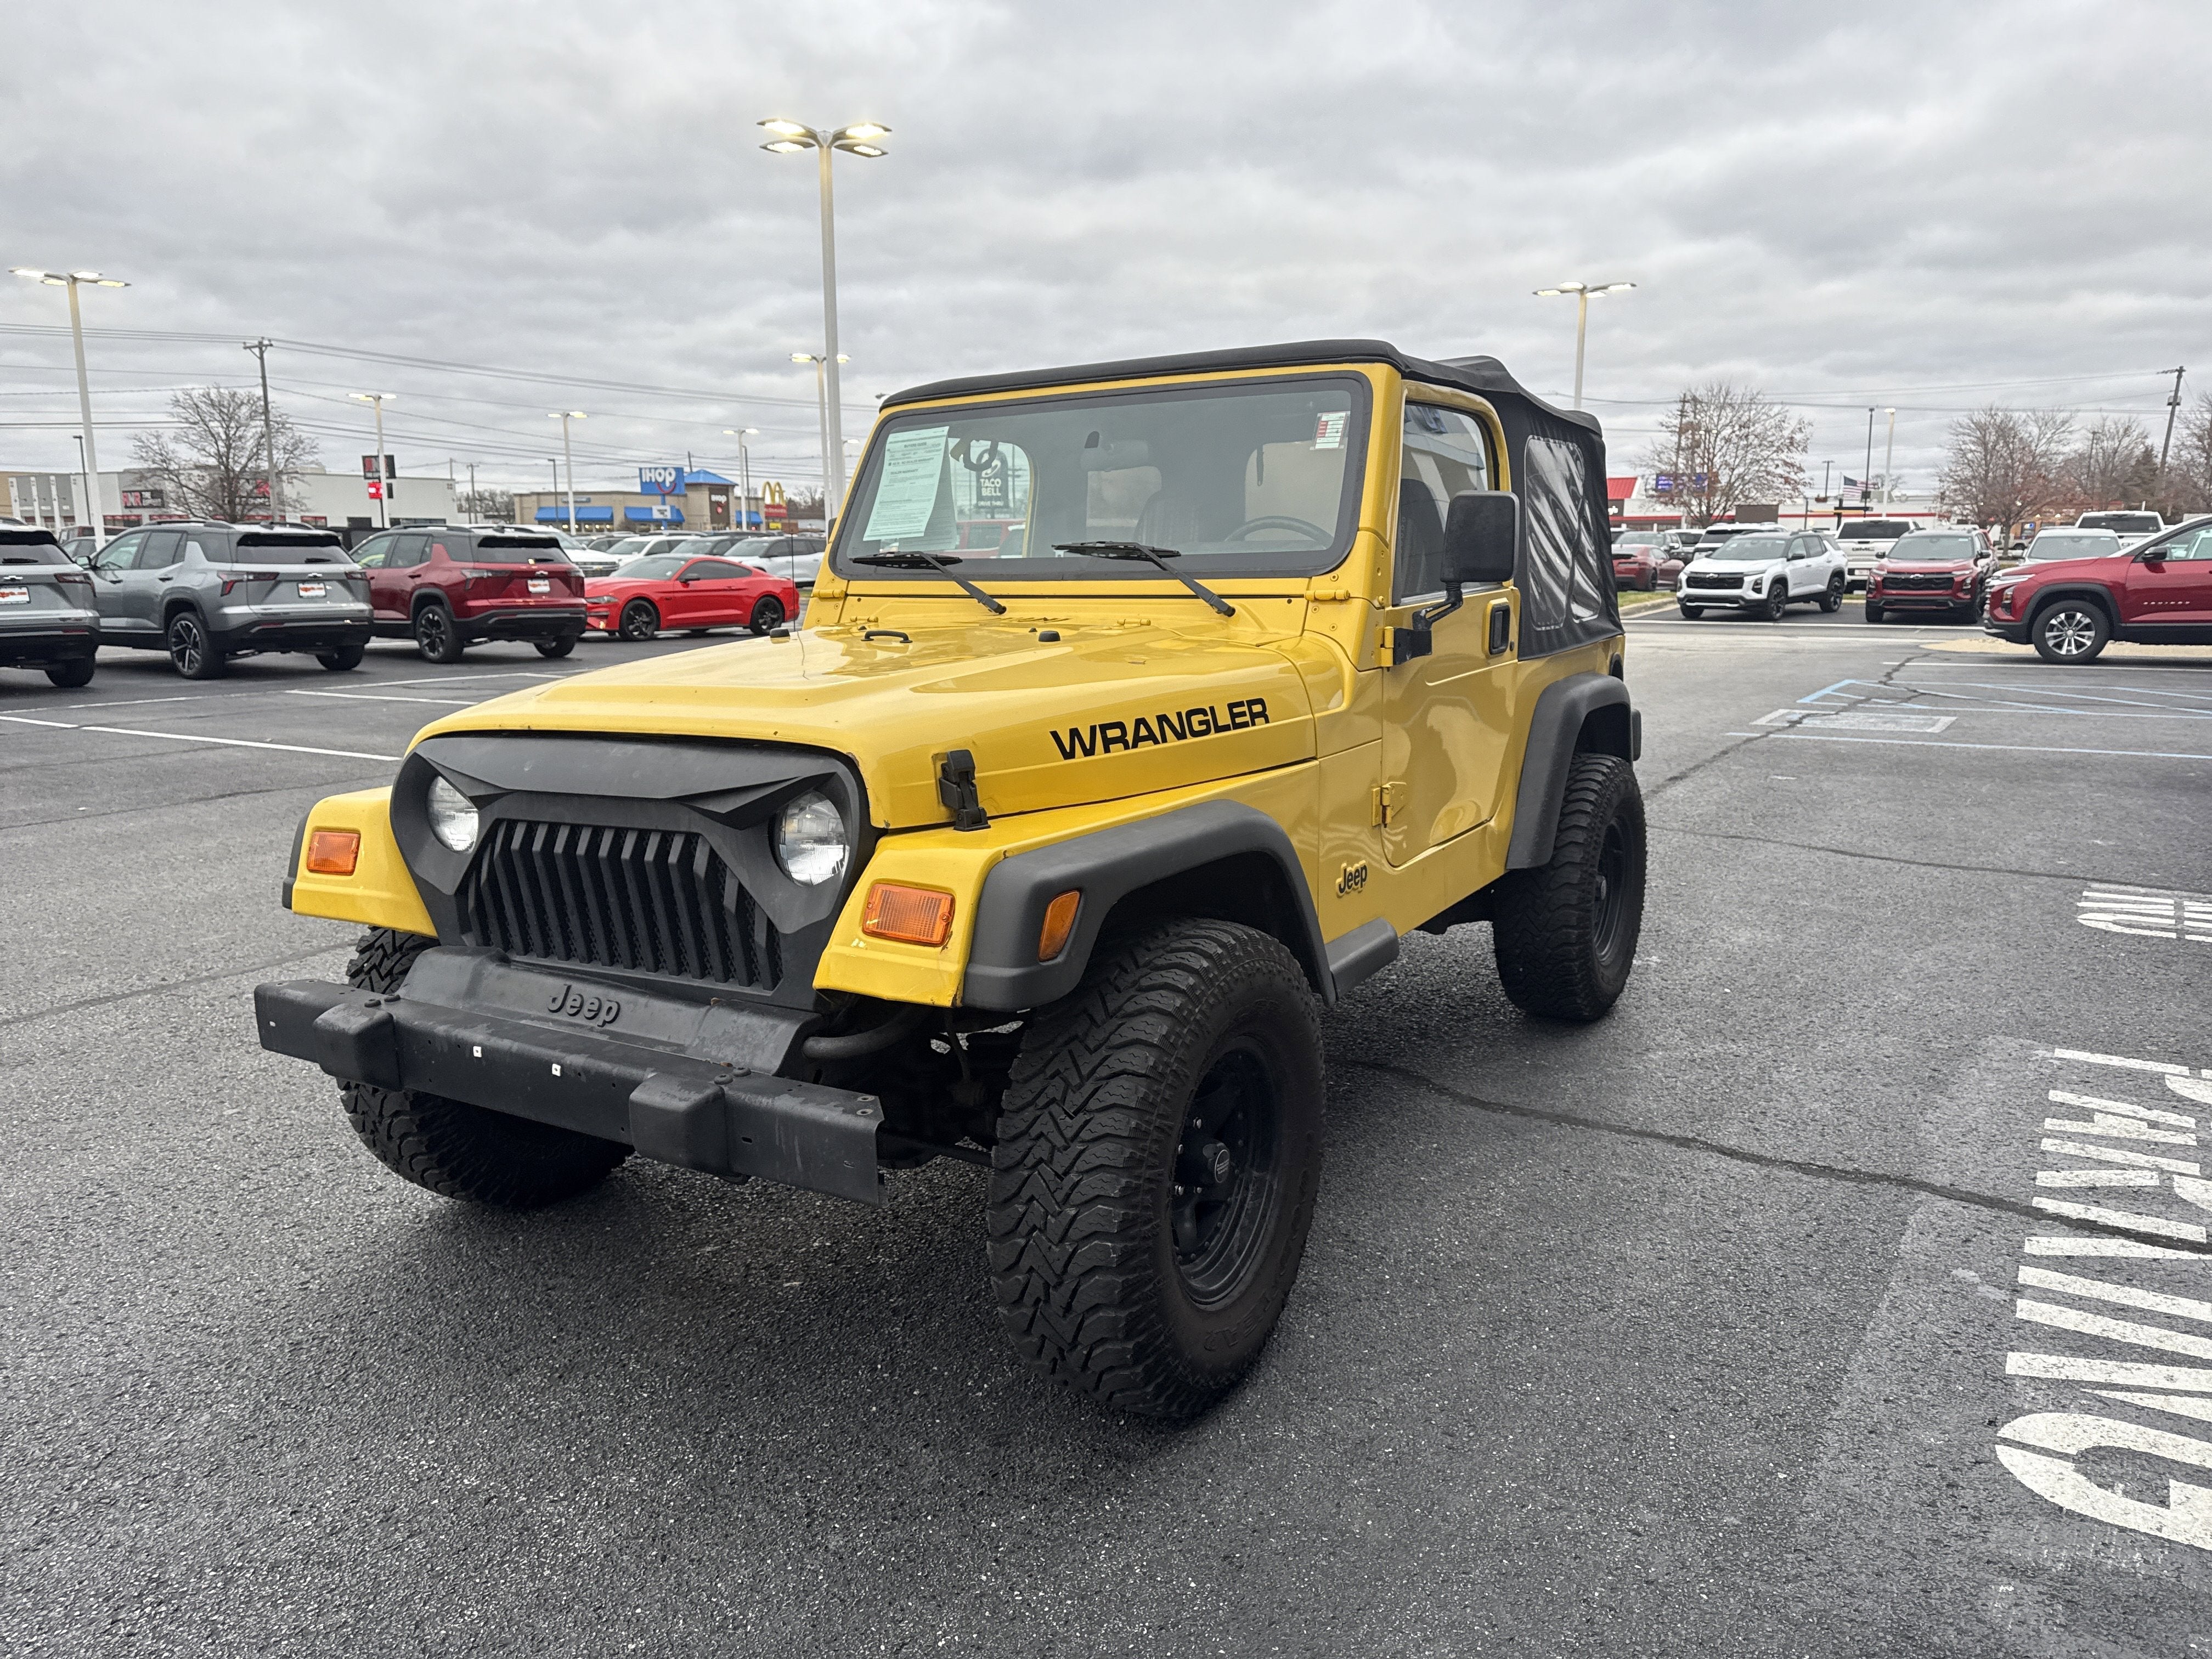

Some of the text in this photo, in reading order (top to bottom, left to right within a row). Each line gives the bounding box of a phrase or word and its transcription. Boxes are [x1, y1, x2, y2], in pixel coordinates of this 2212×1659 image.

[979, 478, 1002, 487] TACO
[981, 487, 1002, 496] BELL
[1049, 697, 1270, 760] WRANGLER
[1337, 862, 1368, 895] Jeep
[548, 984, 620, 1028] Jeep
